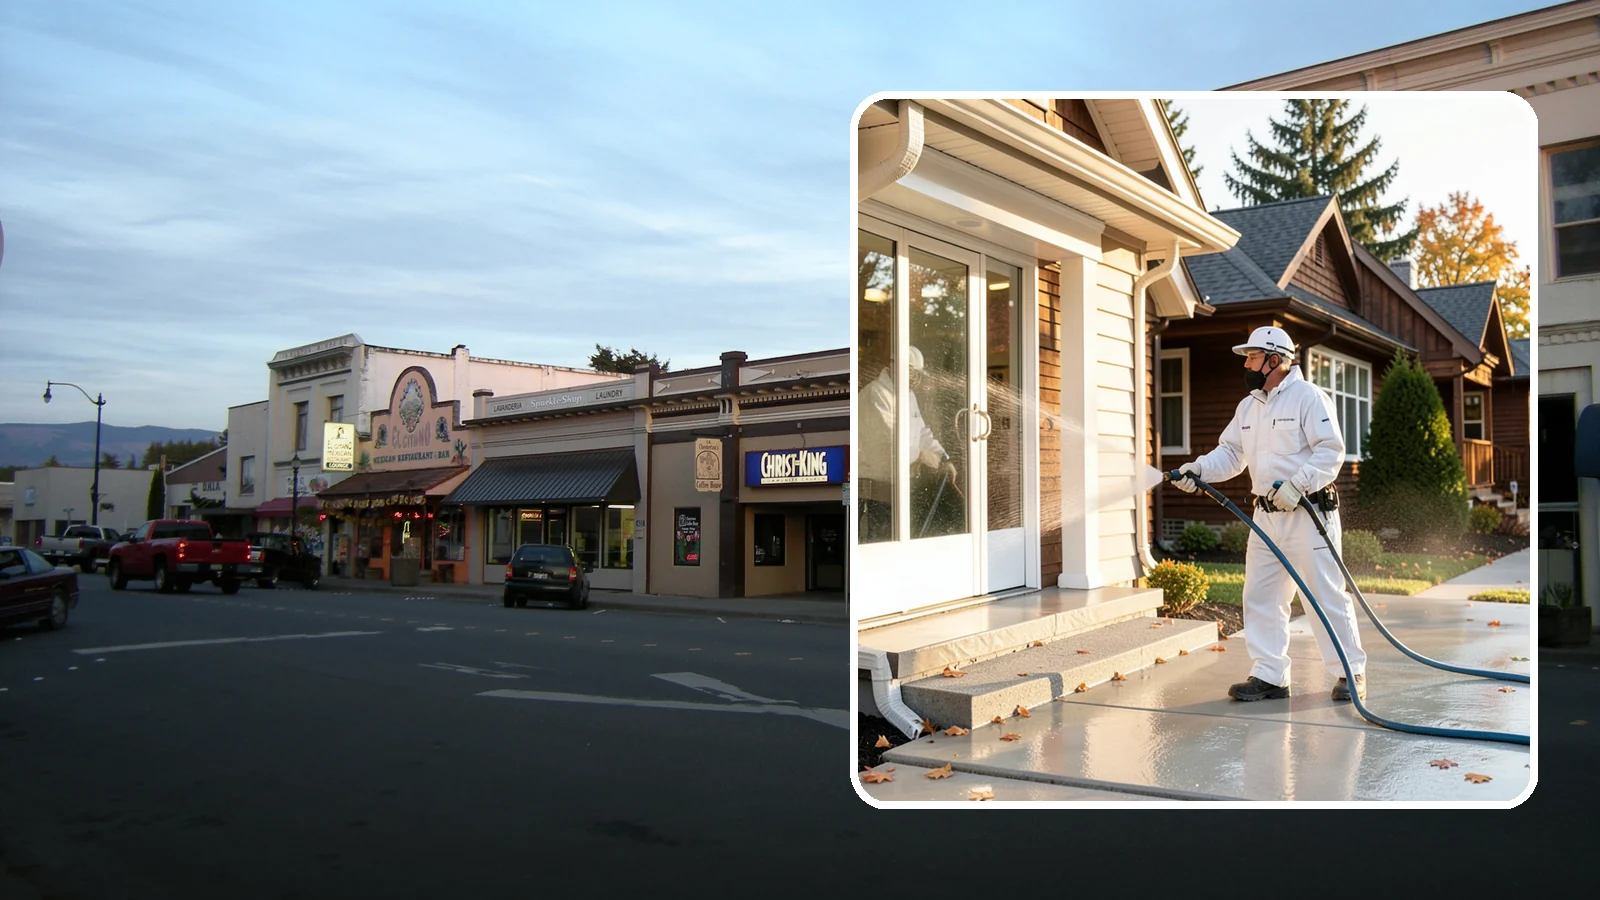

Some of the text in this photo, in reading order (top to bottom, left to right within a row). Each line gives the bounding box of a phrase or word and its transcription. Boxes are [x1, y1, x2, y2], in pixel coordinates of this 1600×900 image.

[493, 402, 522, 413] LAVANDERIA
[562, 394, 582, 405] Shop
[595, 389, 624, 400] LAUNDRY
[373, 450, 450, 464] MEXICAN RESTAURANT BAR
[761, 450, 827, 477] CHRIST KING
